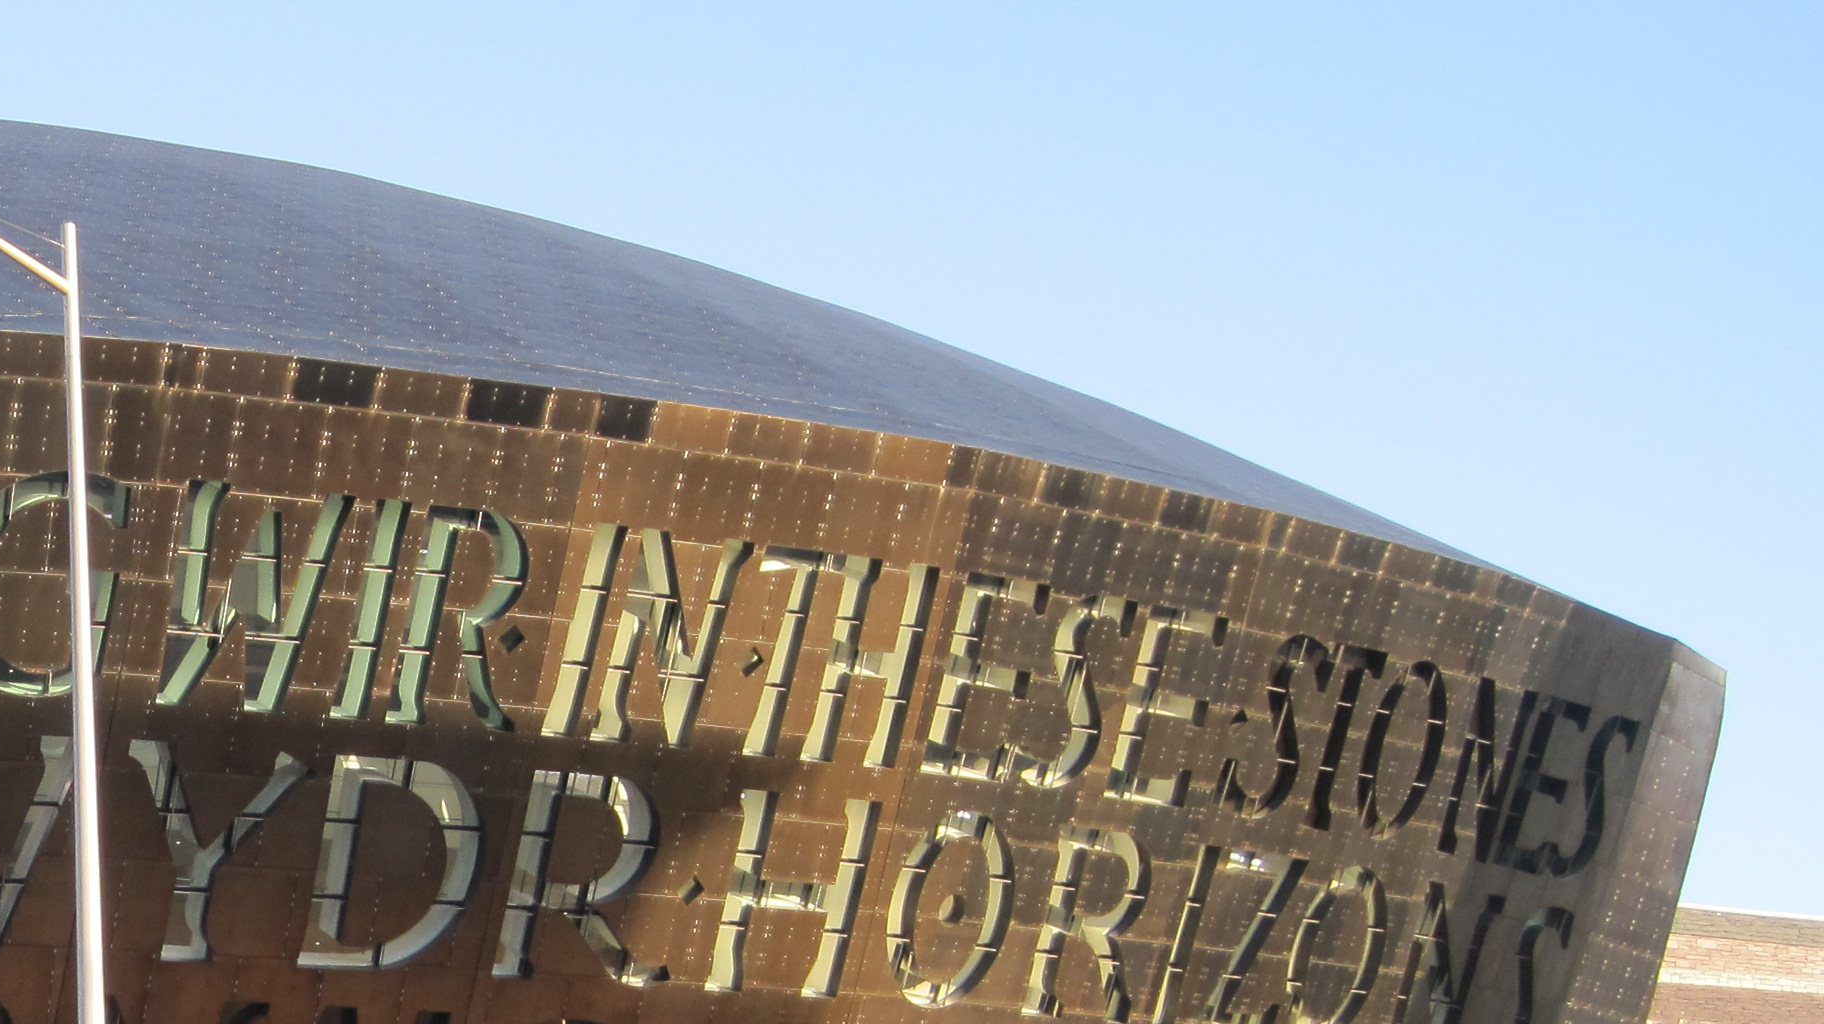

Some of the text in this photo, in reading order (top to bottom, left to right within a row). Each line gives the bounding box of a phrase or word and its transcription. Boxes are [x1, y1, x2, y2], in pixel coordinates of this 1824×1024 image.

[541, 522, 753, 748] IN
[742, 546, 1229, 807] THESE
[1217, 634, 1640, 878] STONES
